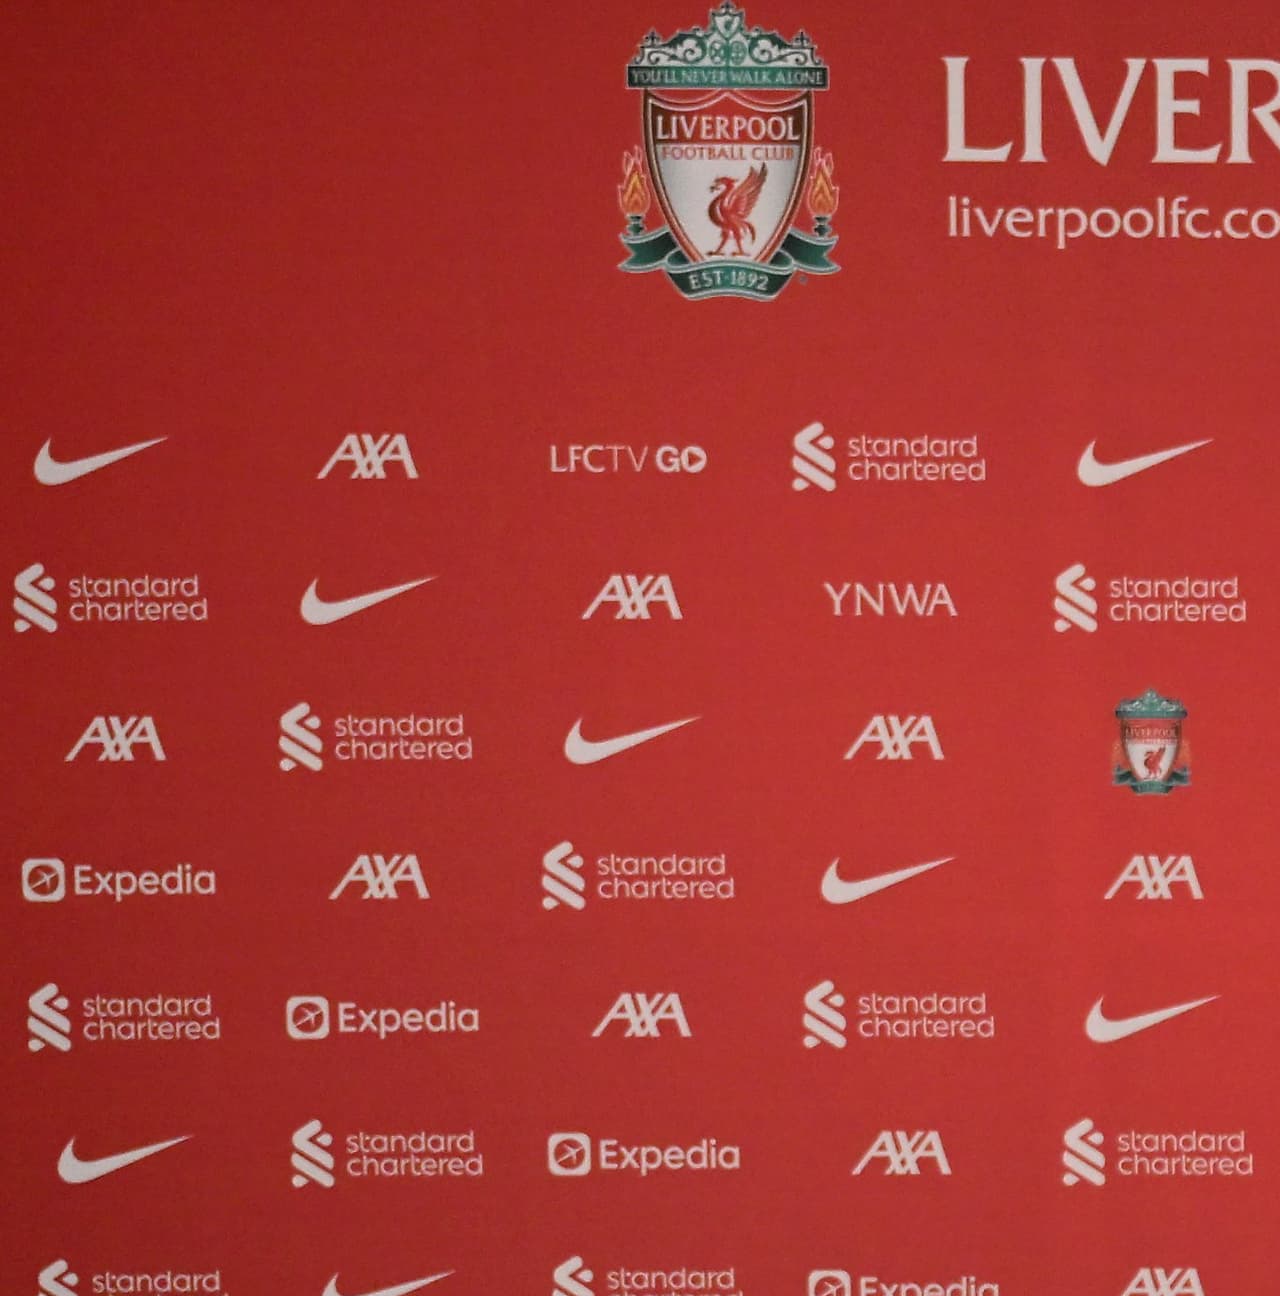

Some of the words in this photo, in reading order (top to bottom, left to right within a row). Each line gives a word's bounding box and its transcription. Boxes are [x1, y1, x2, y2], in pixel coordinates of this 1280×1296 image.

[681, 70, 728, 85] NEVER
[729, 70, 770, 85] WALK
[775, 71, 824, 86] ALONE
[656, 115, 800, 141] LIVERPOOL
[662, 146, 746, 160] FOOTBALL
[751, 146, 794, 160] CLUB
[317, 433, 419, 479] AXA
[848, 435, 977, 457] standard
[848, 459, 986, 481] chartered
[69, 575, 197, 599] standard
[582, 574, 682, 620] AXA
[824, 582, 957, 616] YNWA
[69, 599, 207, 621] chartered
[65, 716, 166, 761] AXA
[844, 715, 944, 760] AXA
[74, 863, 216, 902] Expedia
[329, 854, 430, 900] AXA
[1104, 855, 1204, 899] AXA
[338, 1001, 479, 1039] Expedia
[592, 992, 692, 1037] AXA
[599, 1139, 740, 1176] Expedia
[852, 1130, 951, 1175] AXA
[1118, 1131, 1244, 1153] standard
[1118, 1153, 1253, 1175] chartered
[607, 1268, 735, 1291] standard
